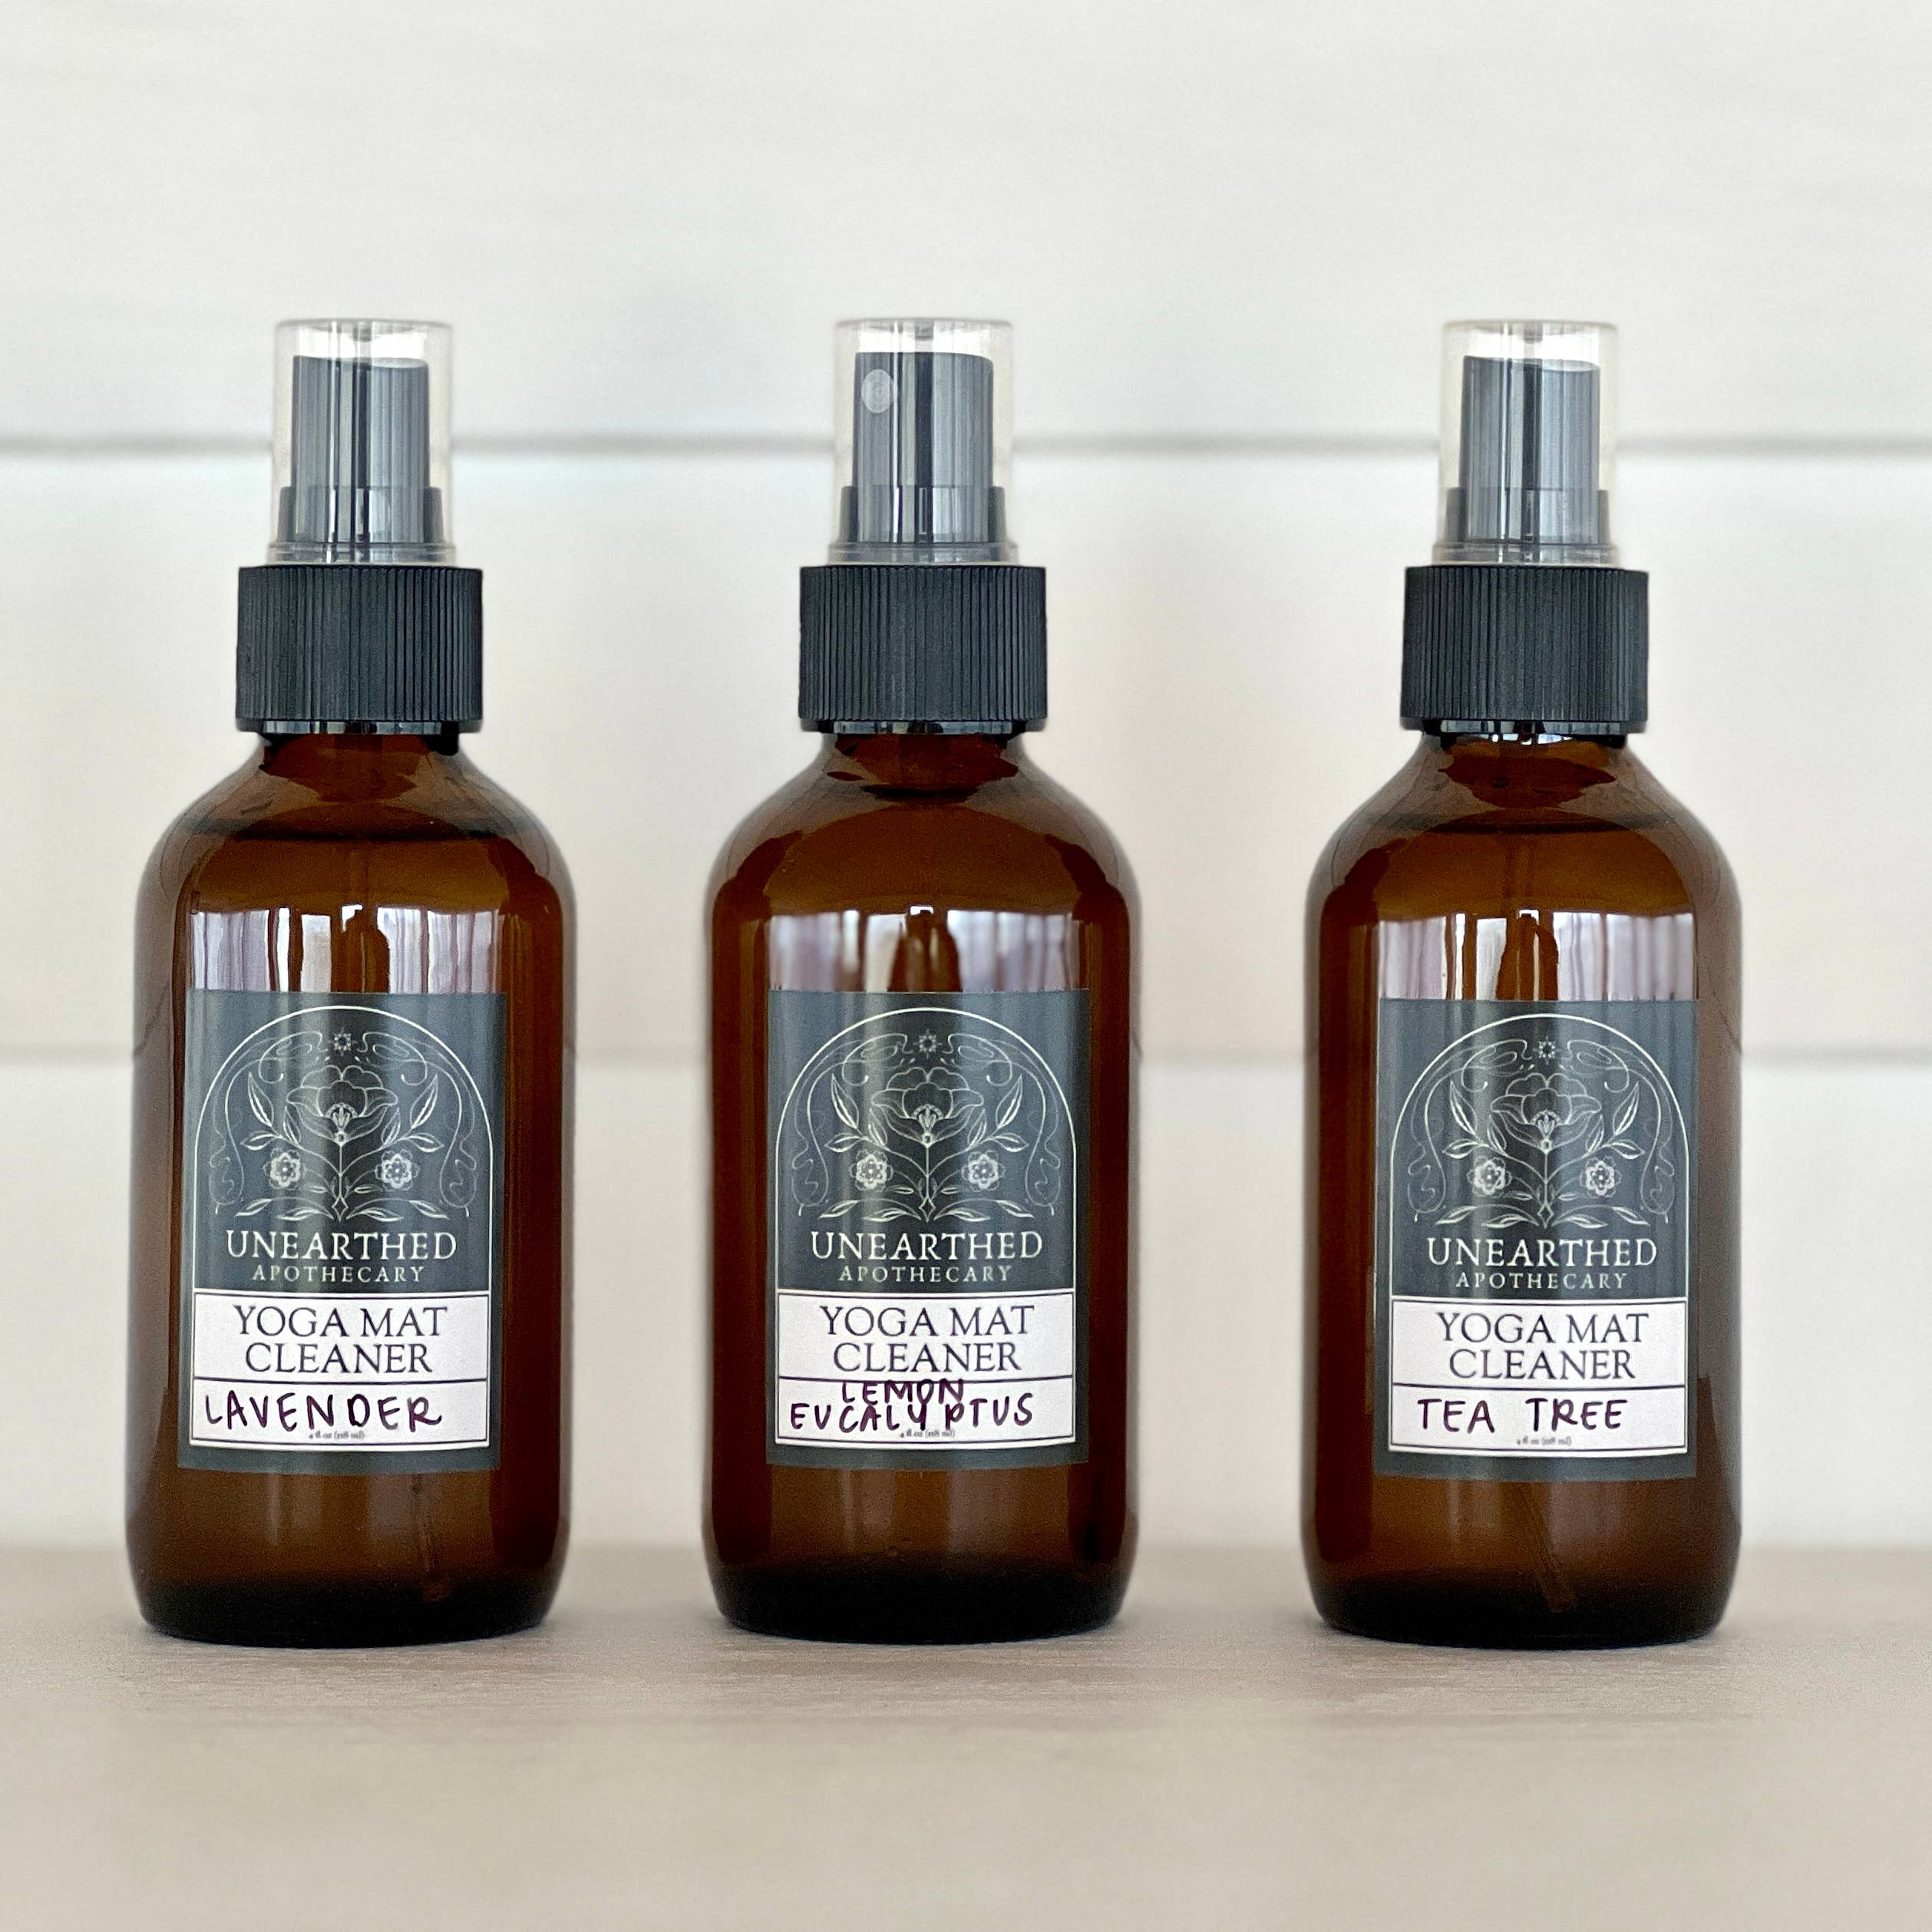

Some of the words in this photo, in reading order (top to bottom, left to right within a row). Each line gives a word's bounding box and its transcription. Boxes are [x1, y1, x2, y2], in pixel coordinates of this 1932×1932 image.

[226, 1230, 457, 1260] UNEARTHED
[811, 1230, 1043, 1260] UNEARTHED
[1427, 1237, 1658, 1267] UNEARTHED
[252, 1264, 428, 1283] APOTHECARY
[838, 1265, 1012, 1283] APOTHECARY
[1455, 1272, 1628, 1290] APOTHECARY
[233, 1305, 351, 1337] YOGA
[359, 1306, 447, 1337] MAT
[820, 1305, 940, 1337] YOGA
[949, 1305, 1035, 1337] MAT
[1436, 1311, 1557, 1344] YOGA
[1565, 1313, 1650, 1344] MAT
[245, 1341, 434, 1374] CLEANER
[833, 1341, 1022, 1373] CLEANER
[1449, 1348, 1636, 1381] CLEANER
[842, 1378, 965, 1405] LEMON
[205, 1389, 443, 1433] LAVENDER
[790, 1392, 1034, 1433] EUCALYPTUS
[1417, 1398, 1496, 1435] TEA
[1524, 1397, 1628, 1433] TREE
